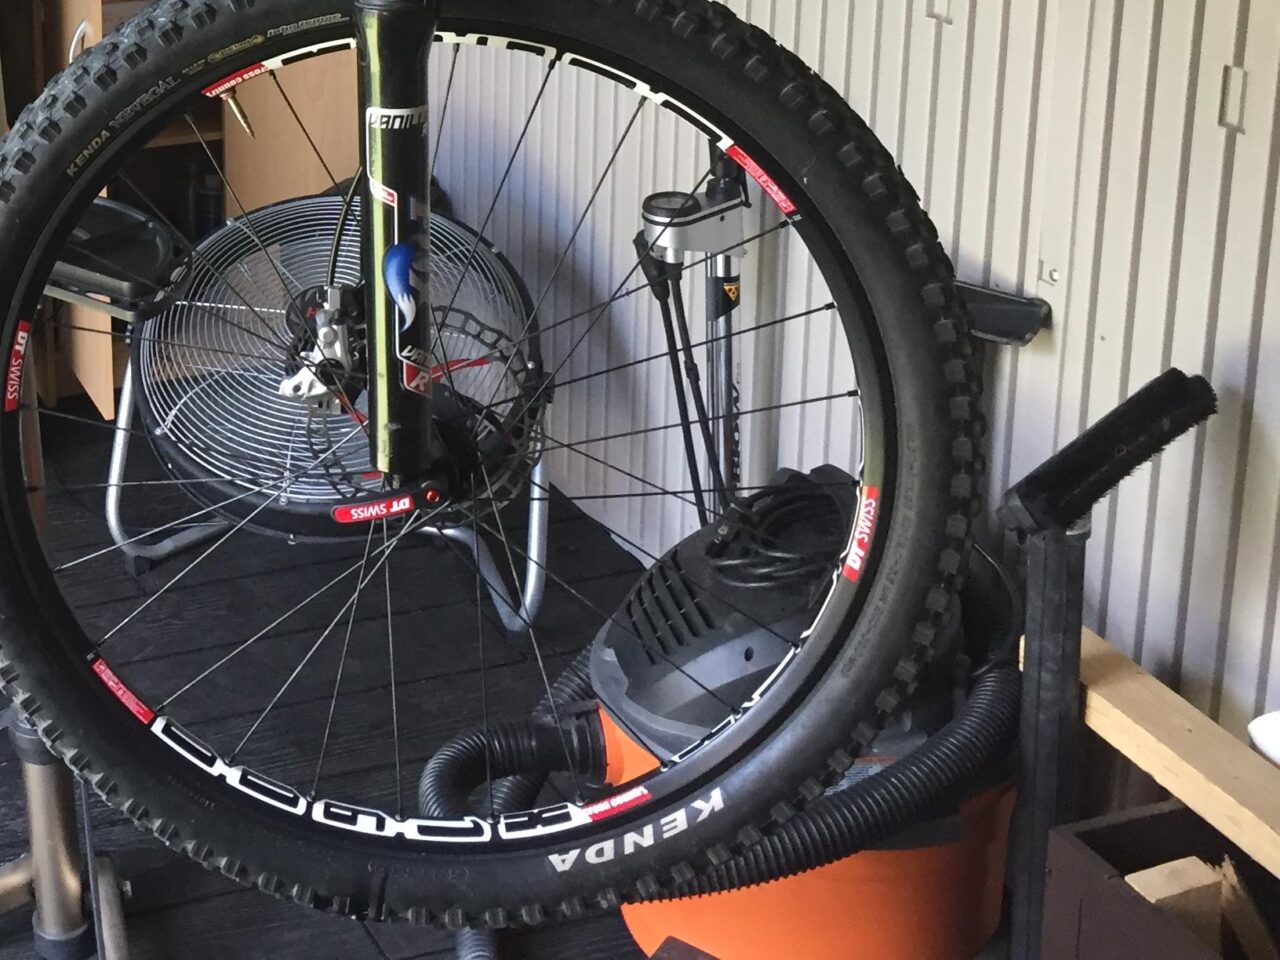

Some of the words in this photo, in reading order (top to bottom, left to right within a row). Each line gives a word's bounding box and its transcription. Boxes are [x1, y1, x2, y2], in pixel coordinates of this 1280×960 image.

[66, 129, 113, 178] KENDA
[15, 331, 28, 354] DT
[7, 358, 22, 401] SWISS
[350, 503, 387, 520] SWISS
[390, 497, 411, 513] DT
[845, 542, 865, 570] DT
[857, 498, 876, 543] SWISS
[548, 786, 725, 874] KENDA
